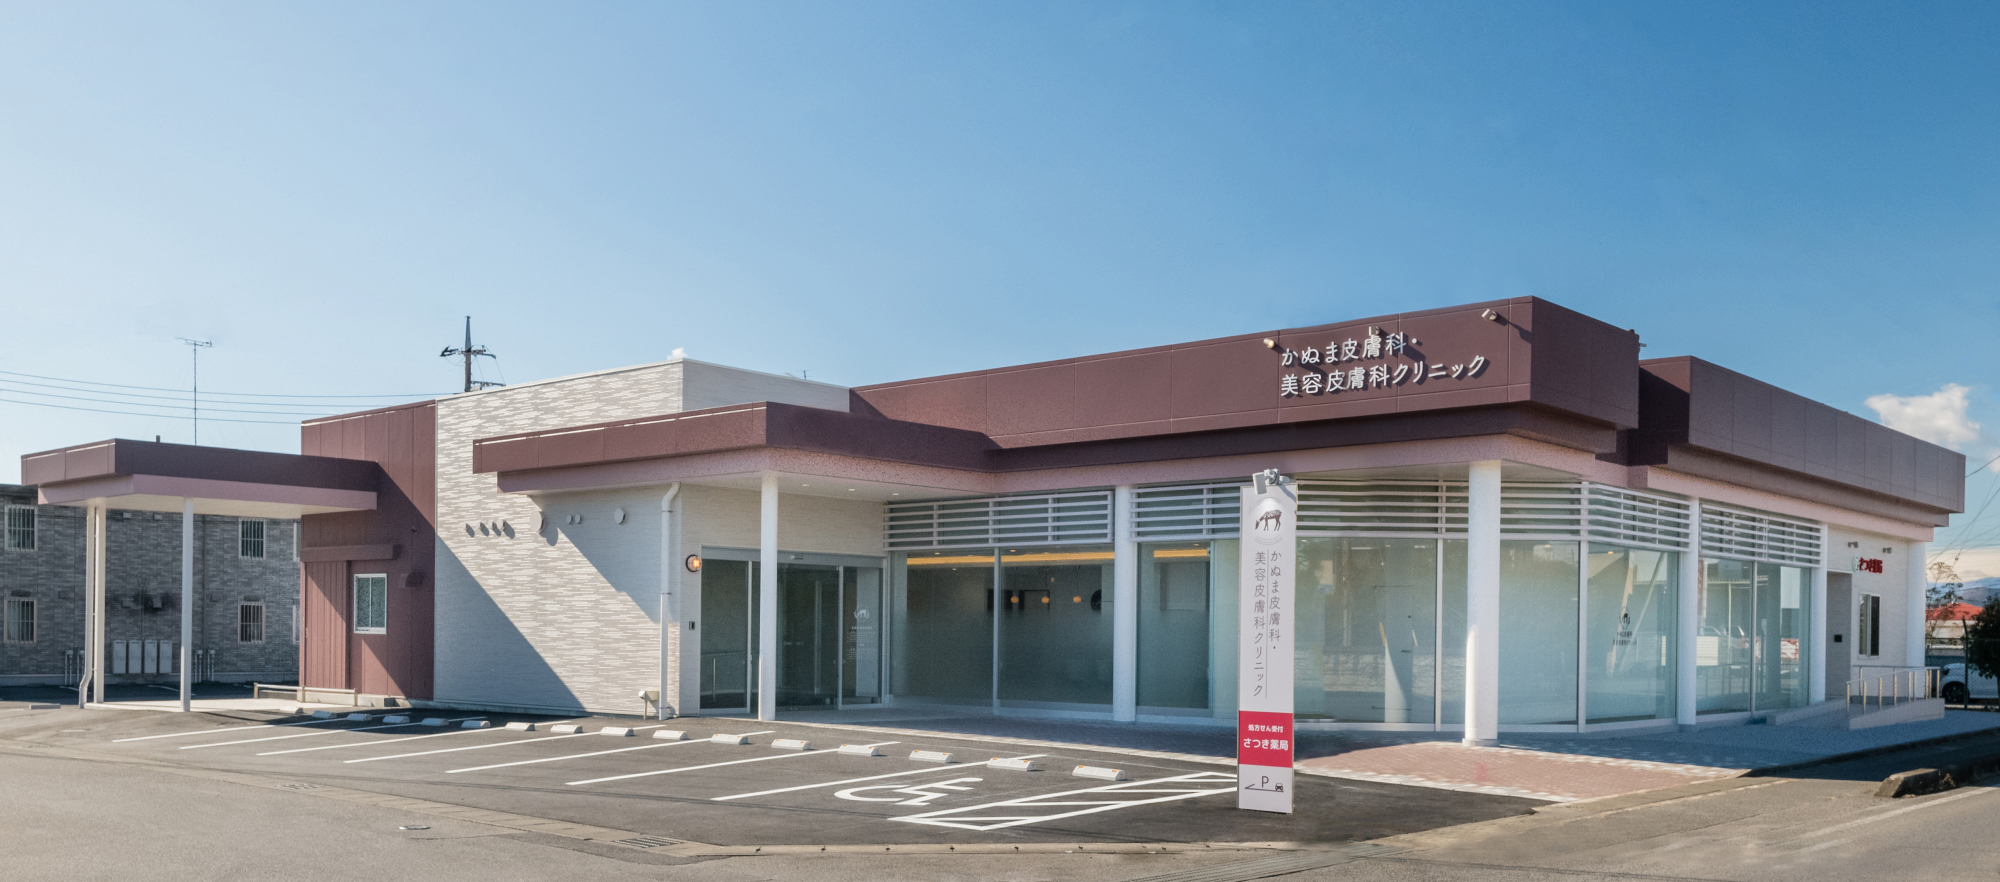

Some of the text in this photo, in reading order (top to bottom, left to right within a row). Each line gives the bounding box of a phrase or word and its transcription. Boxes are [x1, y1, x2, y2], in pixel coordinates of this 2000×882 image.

[1281, 331, 1417, 366] かぬま皮膚科・
[1281, 355, 1485, 396] 美容皮膚科クリニック
[1253, 551, 1266, 697] 美容皮膚科クリニック
[1248, 724, 1284, 733] 処方せん受付
[1243, 738, 1289, 751] さつき薬局
[1261, 775, 1270, 788] P
